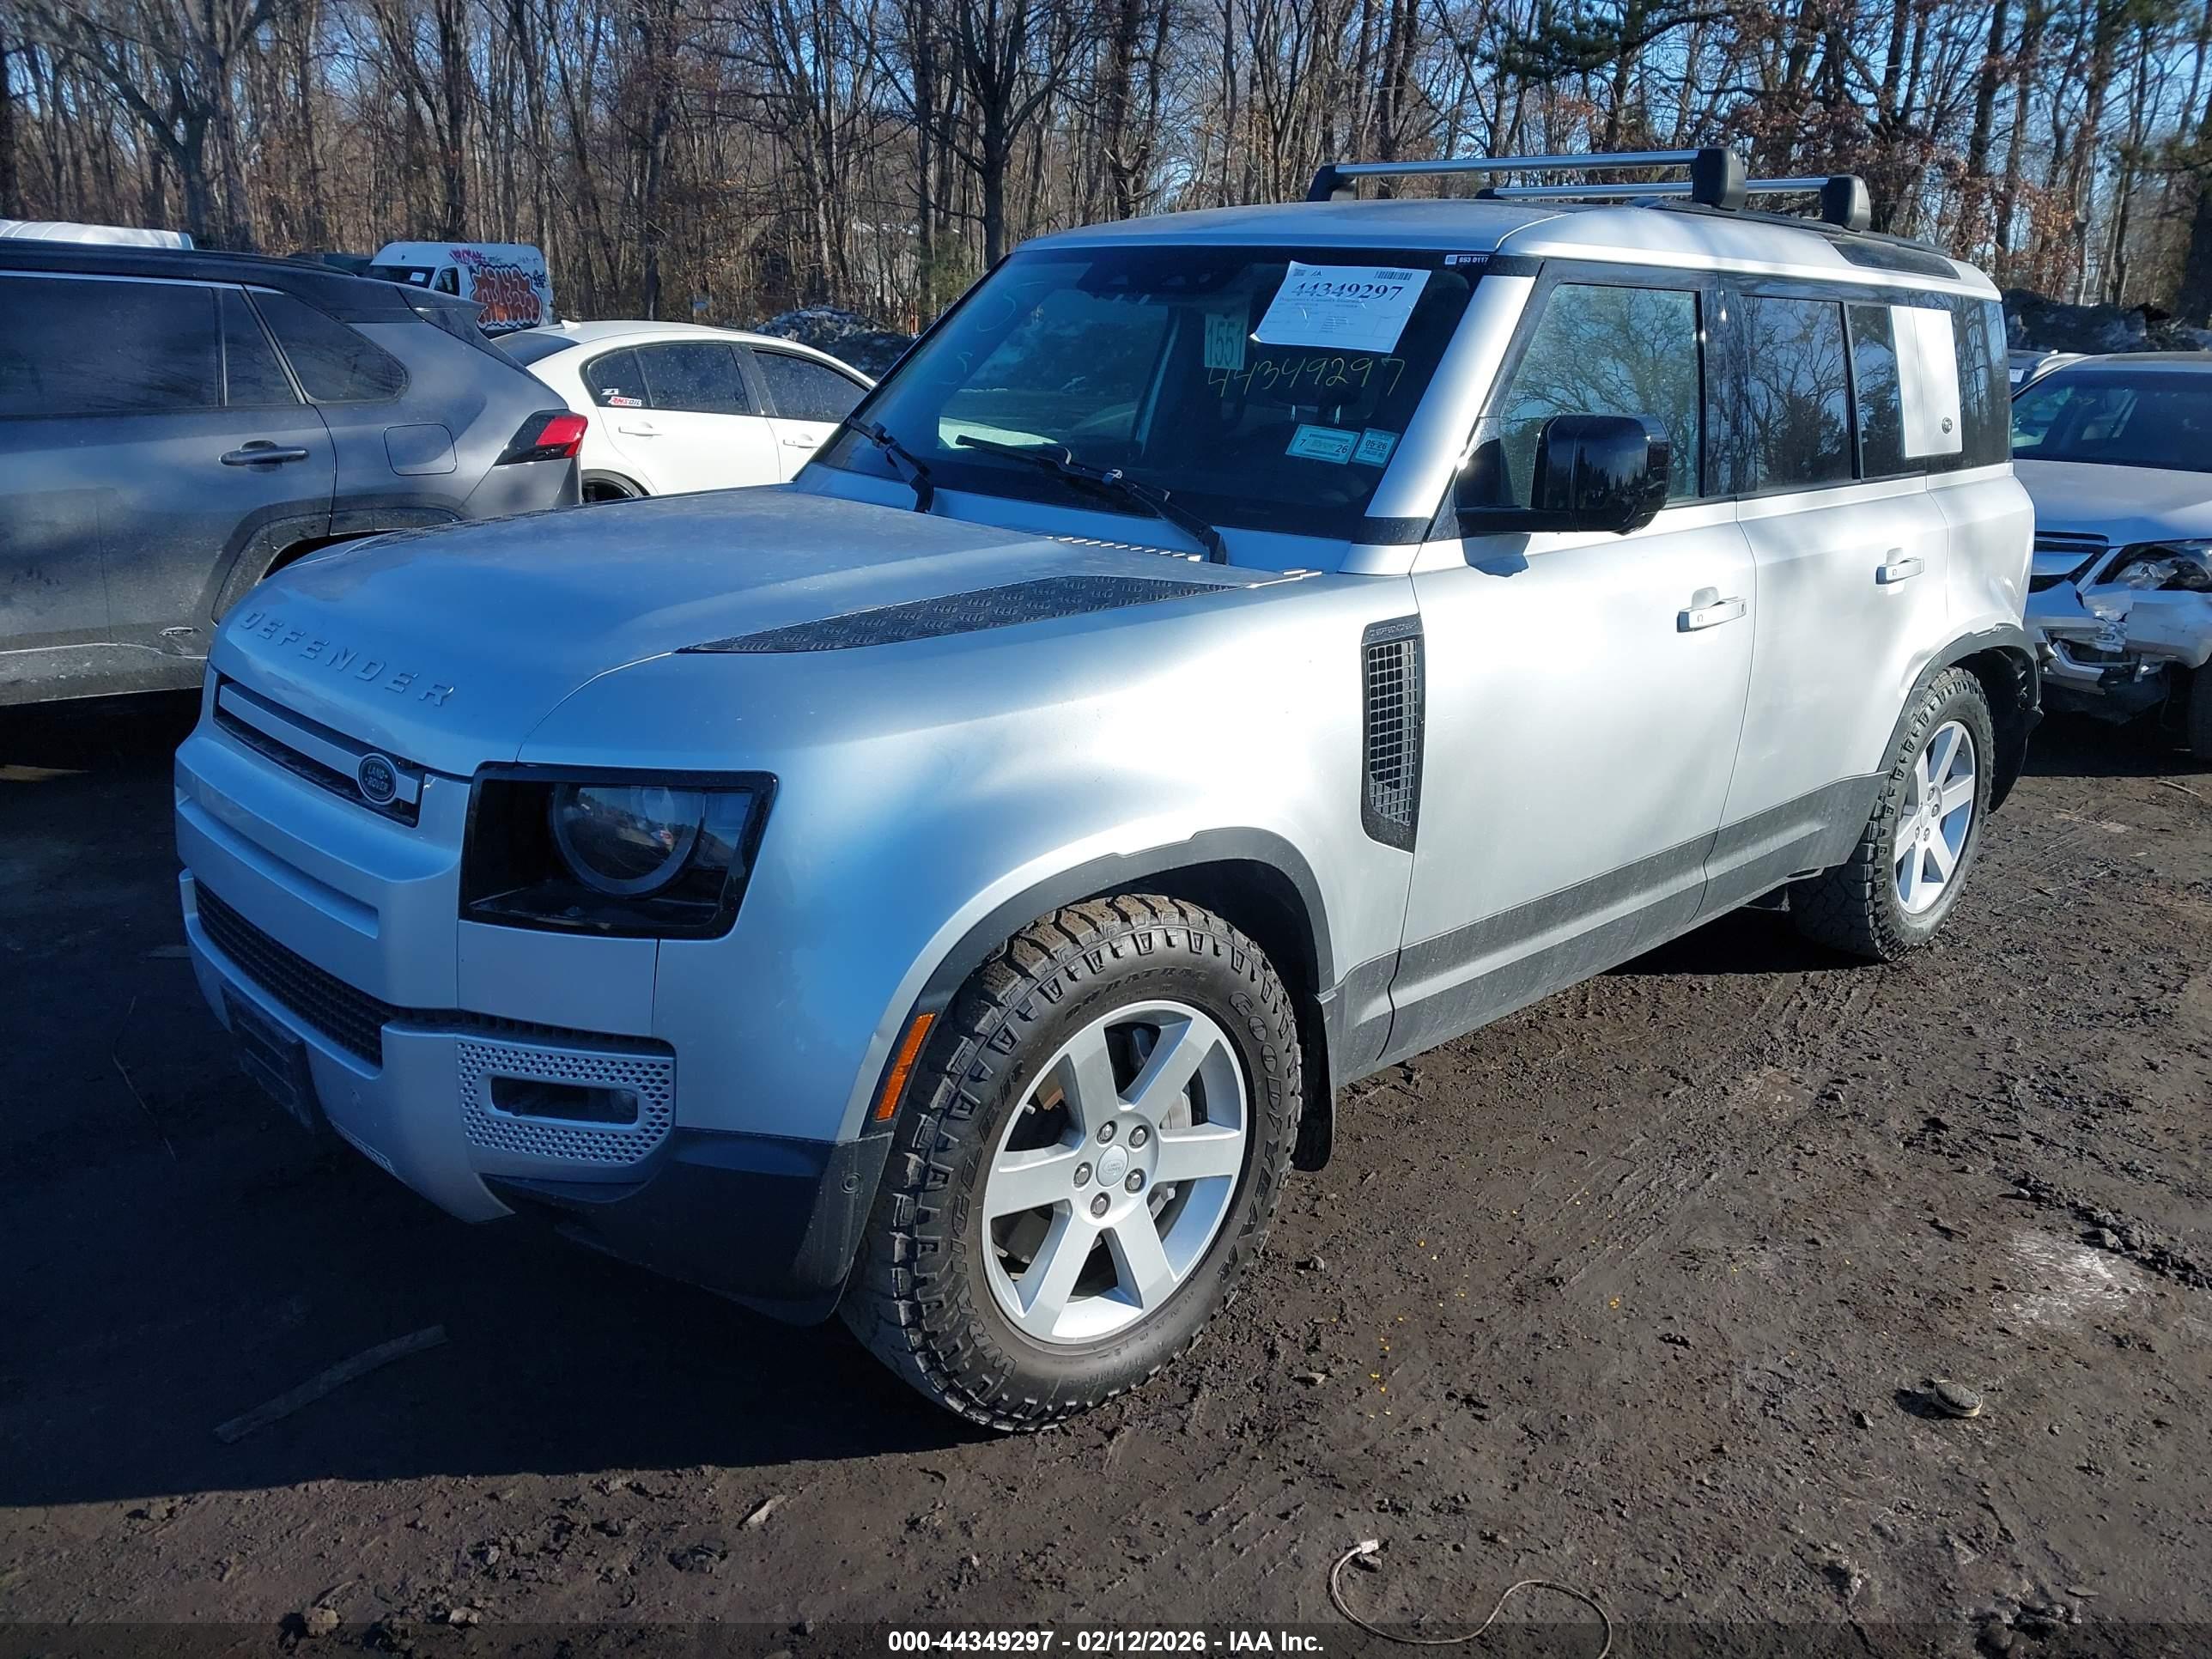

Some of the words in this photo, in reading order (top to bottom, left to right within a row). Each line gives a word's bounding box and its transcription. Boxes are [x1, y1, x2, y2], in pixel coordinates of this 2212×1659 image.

[1291, 282, 1404, 301] 44349297
[1207, 320, 1244, 366] 1551
[1207, 357, 1406, 398] 44349297
[1334, 444, 1349, 453] 26
[240, 611, 455, 707] DEFENDER
[1218, 992, 1283, 1283] GOODYEAR
